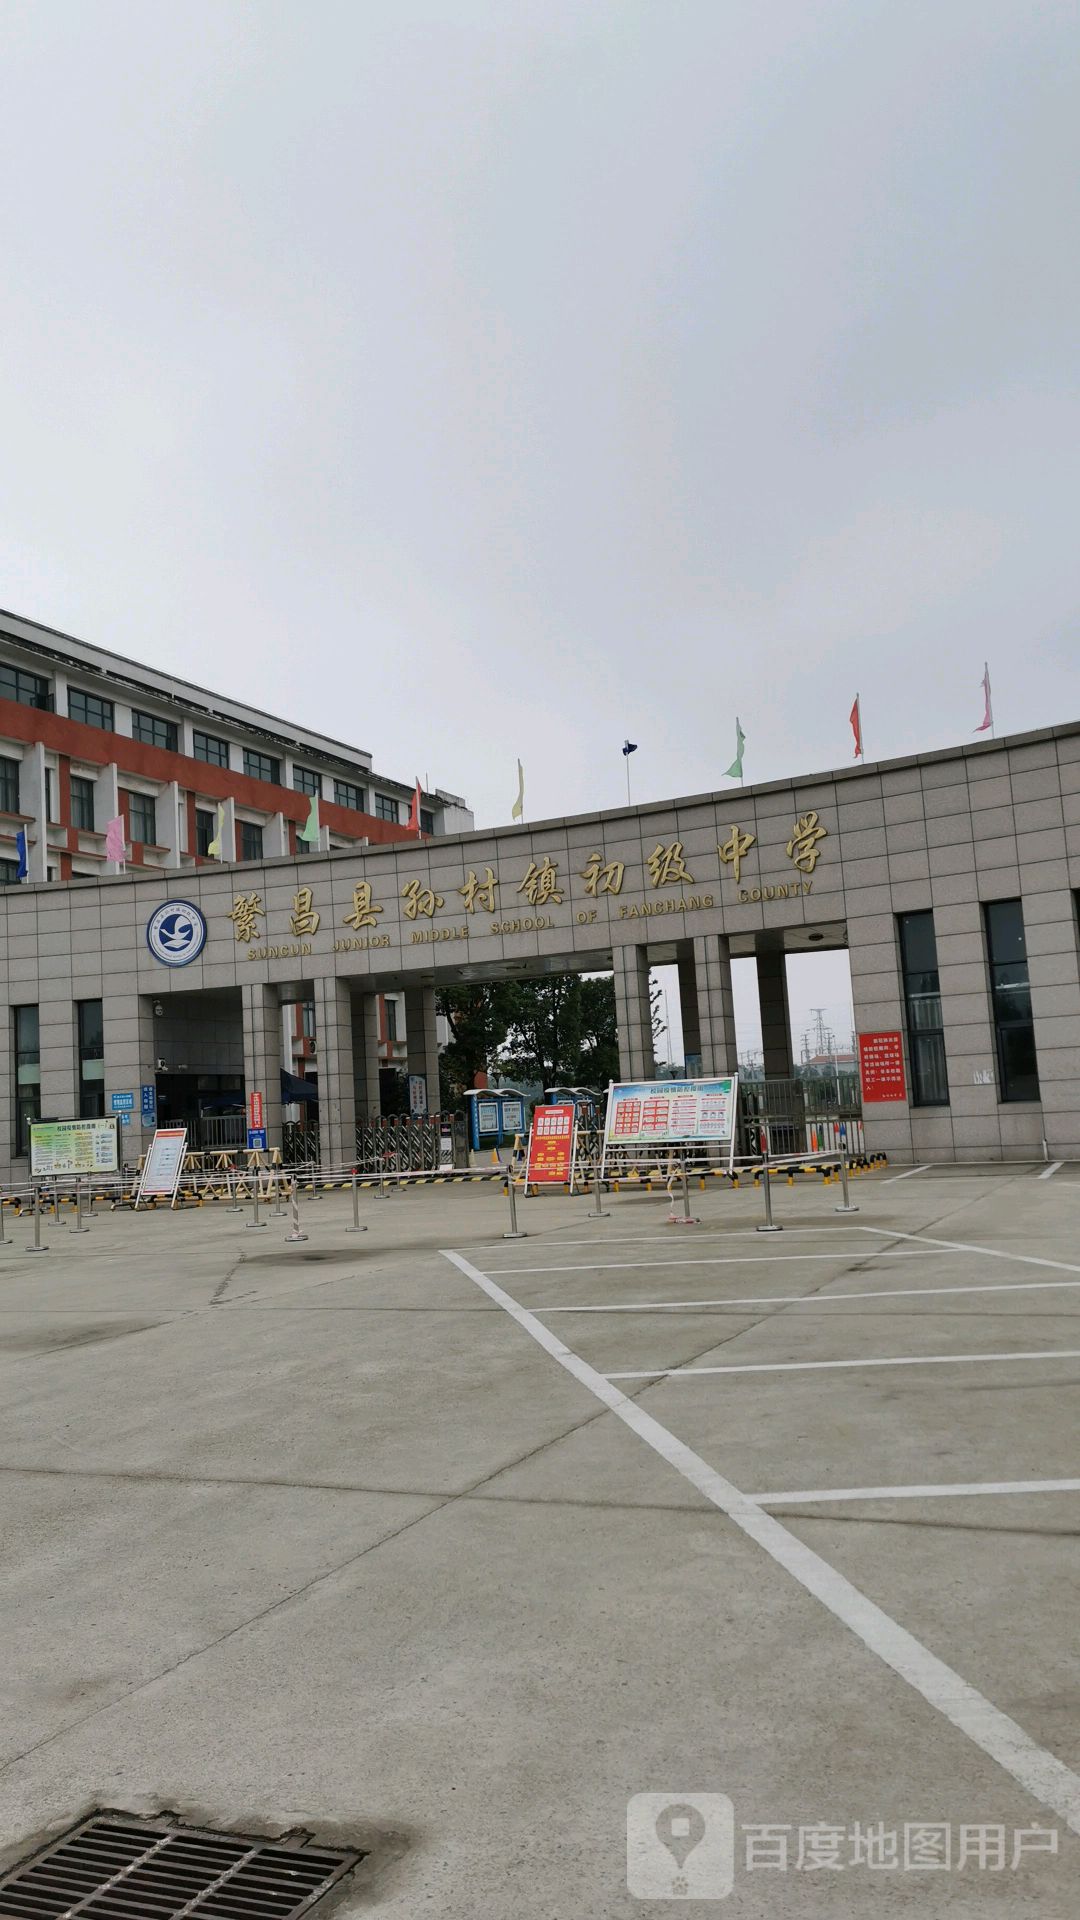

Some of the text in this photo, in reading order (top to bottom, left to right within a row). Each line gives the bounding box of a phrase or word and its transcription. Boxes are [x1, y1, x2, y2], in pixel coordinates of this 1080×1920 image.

[227, 810, 828, 943] 繁昌县孙村镇初级中学
[247, 880, 814, 961] SUNCUN JUNIOR MIDDLE SCHOOL OF FANCHANG COUNTY
